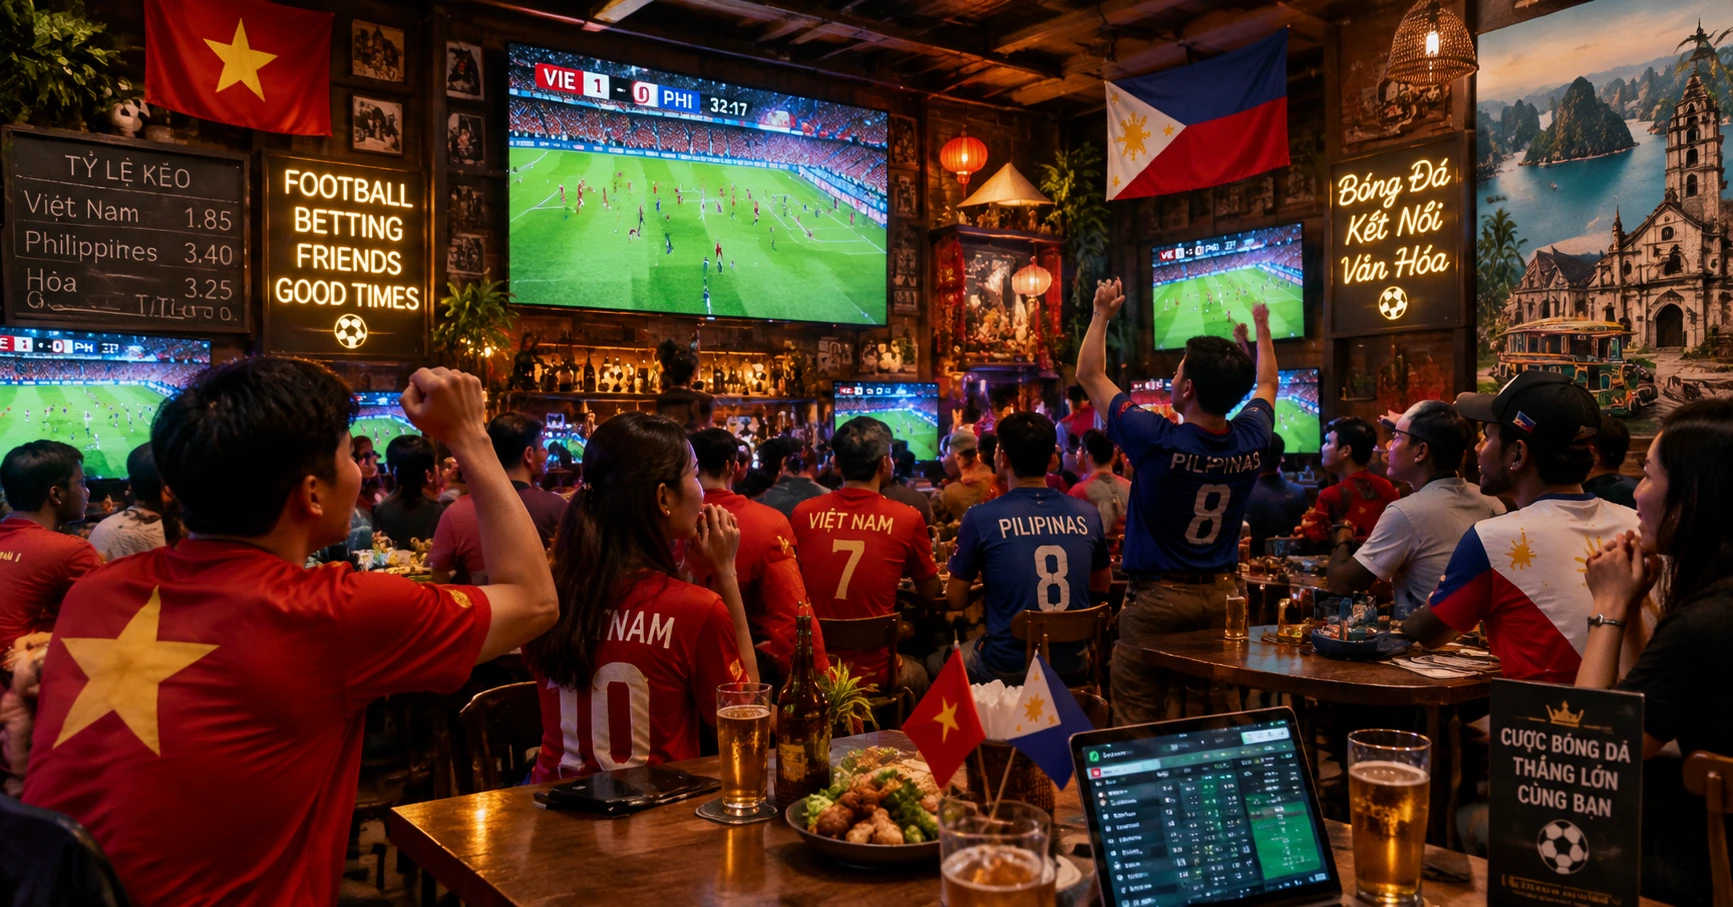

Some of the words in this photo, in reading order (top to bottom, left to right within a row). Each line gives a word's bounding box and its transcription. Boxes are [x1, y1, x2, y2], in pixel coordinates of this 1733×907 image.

[543, 67, 577, 90] VIE
[593, 78, 602, 94] 1
[663, 89, 693, 109] PHI
[709, 97, 748, 117] 32:17
[285, 169, 414, 208] FOOTBALL
[1337, 172, 1403, 209] Bóng
[1408, 157, 1452, 193] Đá
[87, 198, 139, 223] Nam
[184, 207, 232, 232] 1.85
[294, 206, 403, 242] BETTING
[1344, 209, 1390, 246] Kết
[25, 230, 158, 264] Philippines
[184, 242, 233, 266] 3.40
[297, 243, 402, 275] FRIENDS
[1394, 244, 1451, 279] Hóa
[184, 277, 233, 300] 3.25
[275, 277, 347, 306] GOOD
[351, 282, 420, 311] TIMES
[851, 513, 894, 535] NAM
[998, 515, 1089, 539] PILIPINAS
[1184, 483, 1231, 545] 8
[832, 538, 865, 600] 7
[1034, 545, 1071, 612] 8
[607, 608, 675, 649] NAM
[547, 661, 650, 779] 10
[1573, 793, 1612, 820] BẠN
